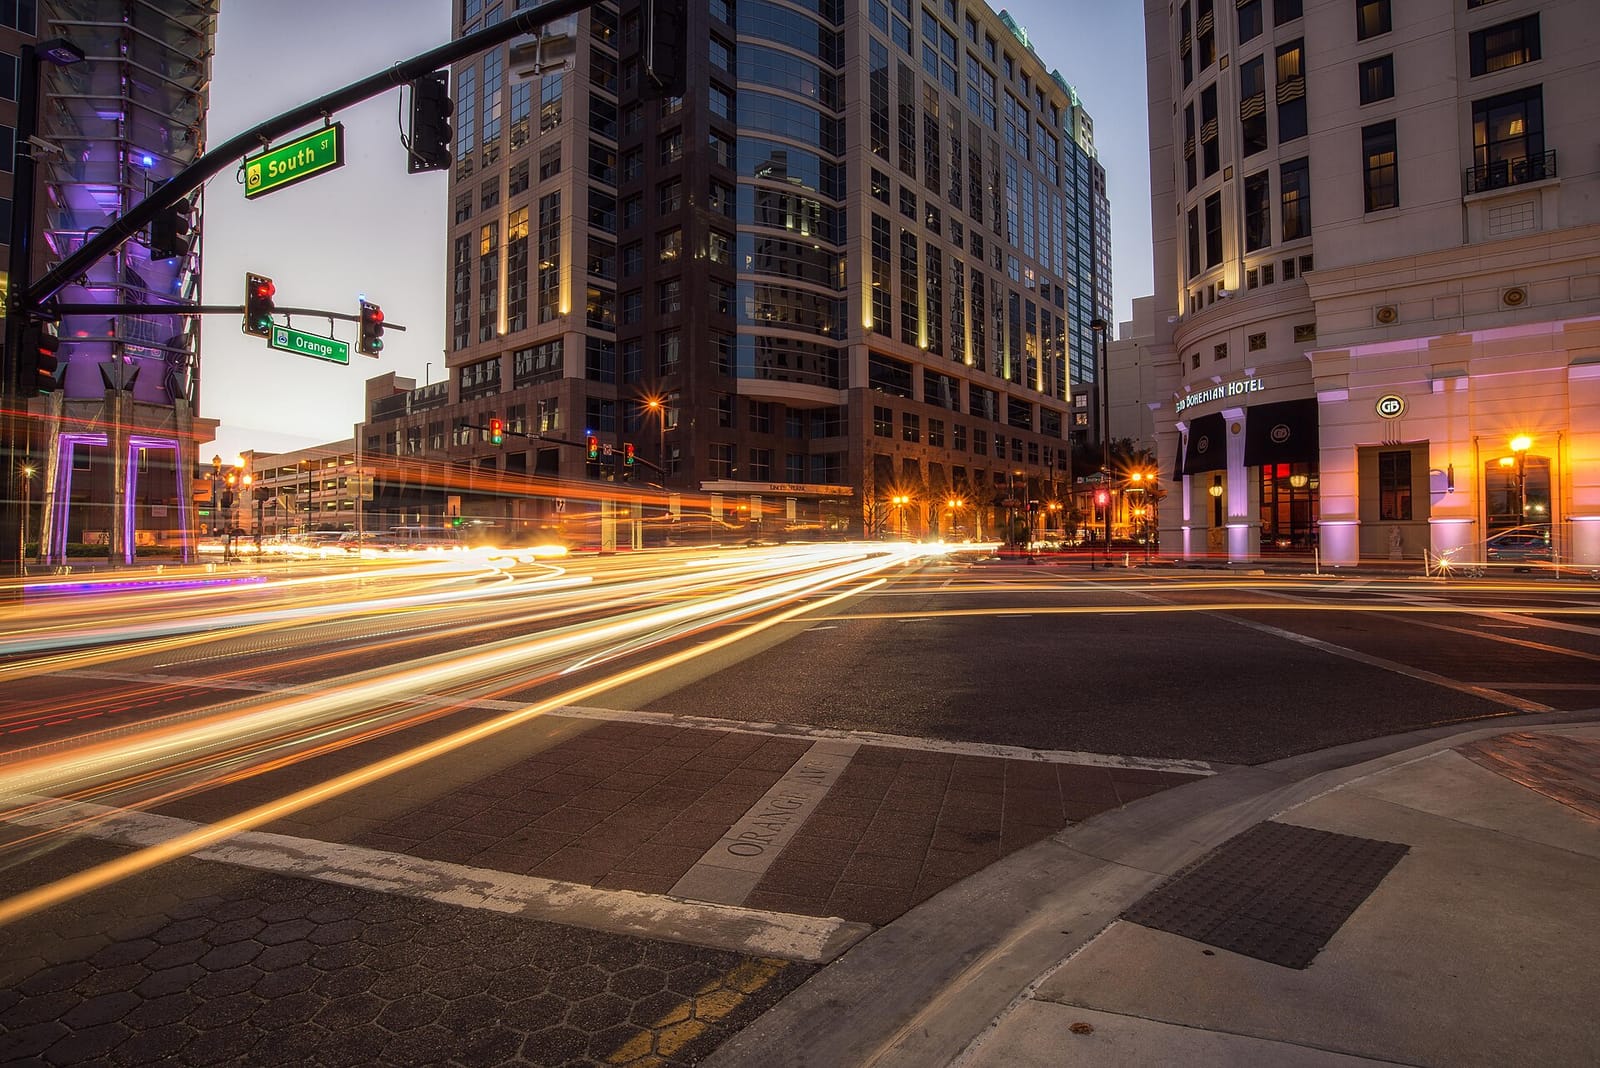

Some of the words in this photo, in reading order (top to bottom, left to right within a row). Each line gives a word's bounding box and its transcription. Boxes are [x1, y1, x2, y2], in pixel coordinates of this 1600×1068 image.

[268, 147, 315, 178] South
[320, 139, 329, 150] ST
[296, 336, 333, 356] Orange
[1186, 386, 1225, 408] BOHEMIAN
[1229, 379, 1265, 396] HOTEL
[1381, 400, 1400, 413] GB
[727, 790, 809, 857] ORANGE
